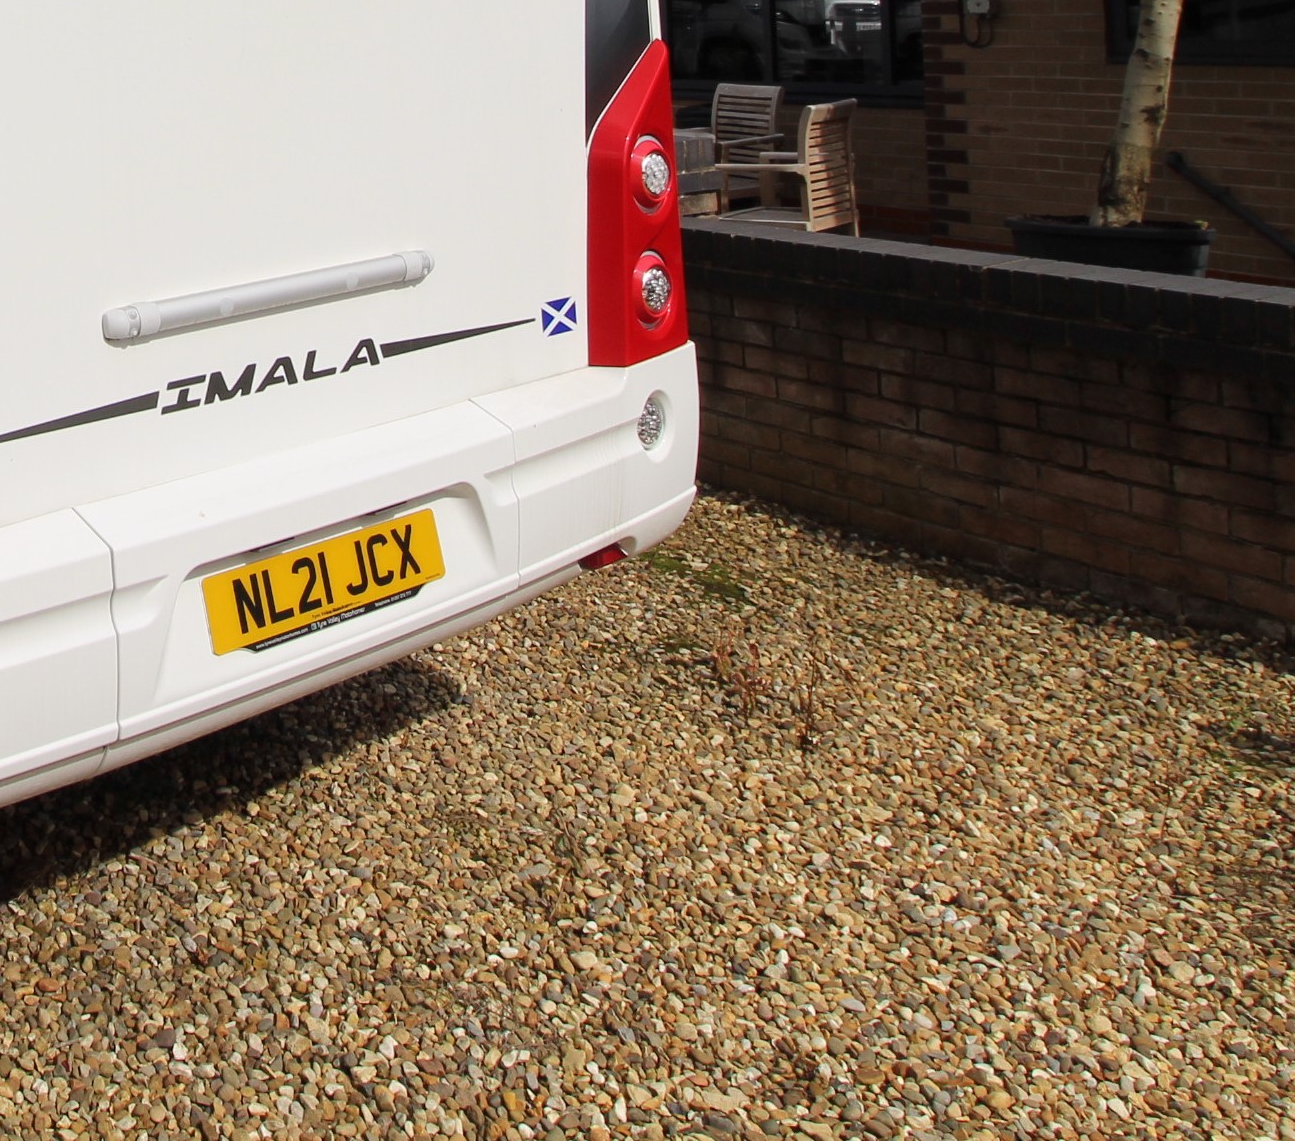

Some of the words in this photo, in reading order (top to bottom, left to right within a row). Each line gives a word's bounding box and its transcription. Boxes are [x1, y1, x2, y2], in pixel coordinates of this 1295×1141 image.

[160, 337, 380, 416] IMALA
[232, 551, 334, 635] NL21
[346, 524, 421, 596] JCX
